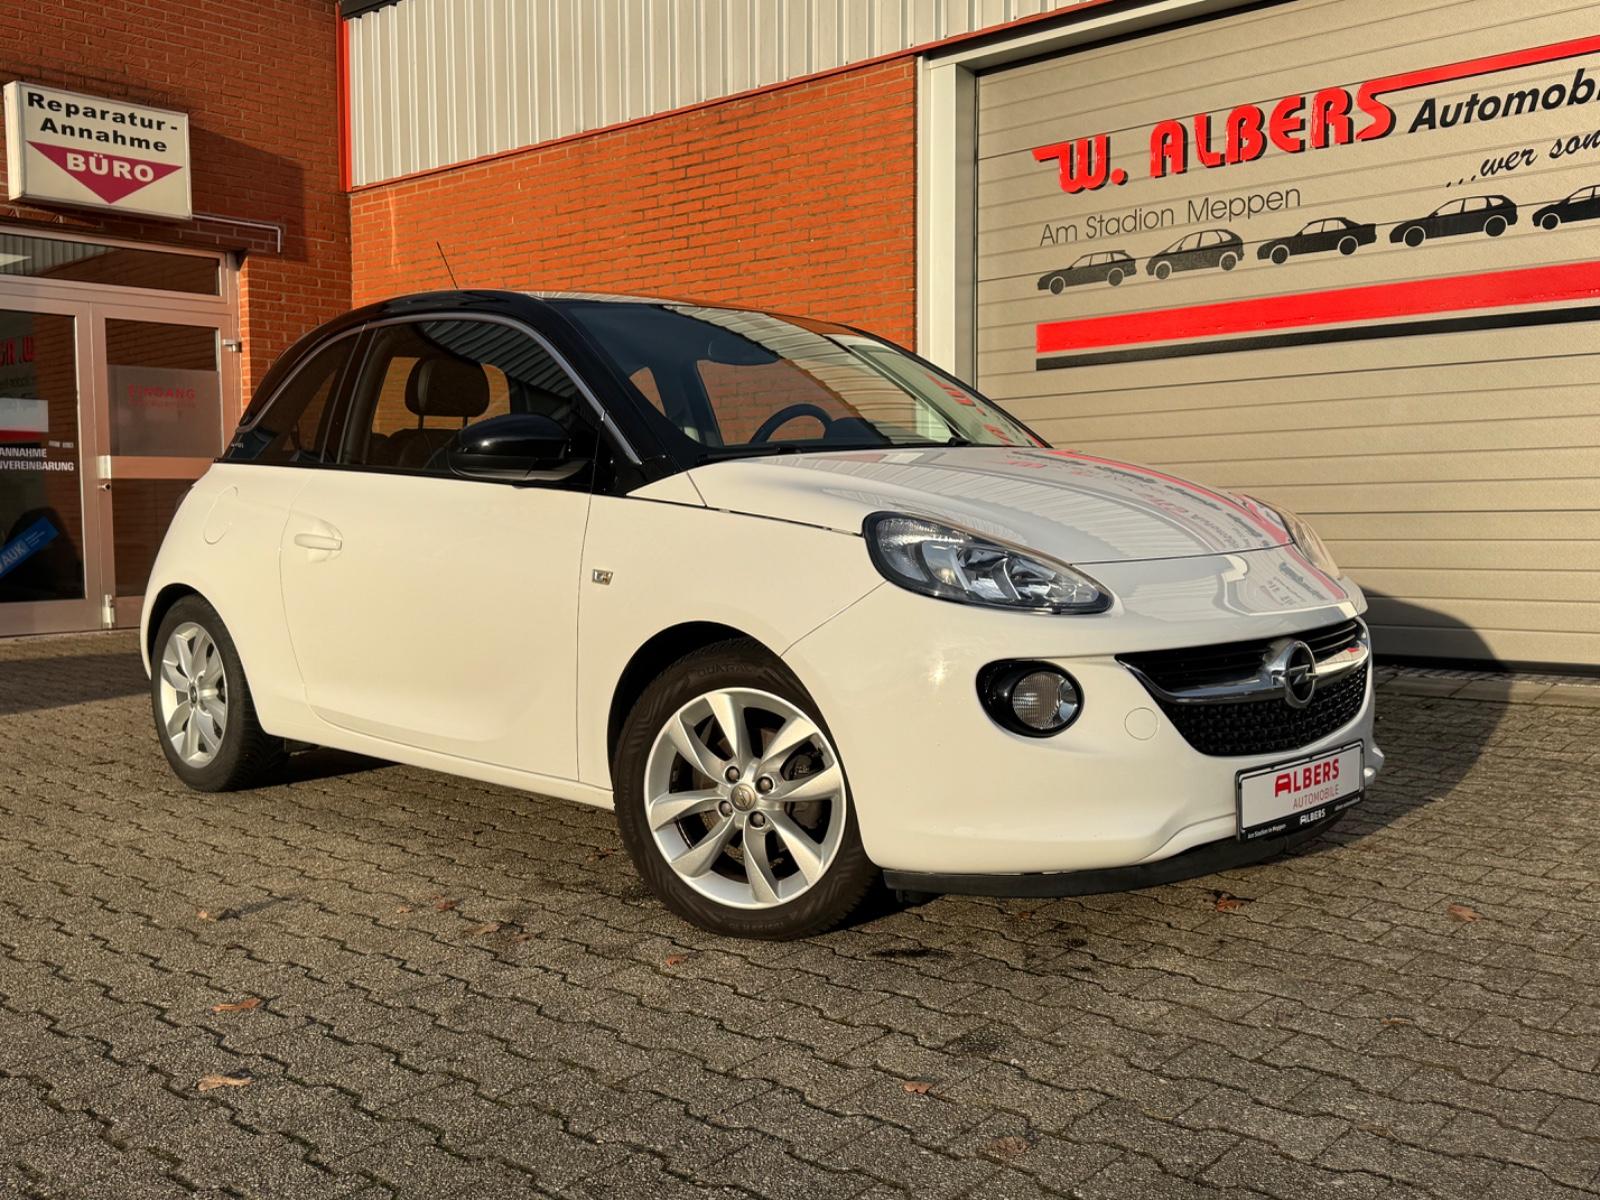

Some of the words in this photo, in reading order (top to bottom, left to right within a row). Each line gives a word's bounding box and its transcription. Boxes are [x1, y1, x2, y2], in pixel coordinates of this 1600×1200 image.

[27, 92, 178, 131] Reparatur-
[40, 117, 167, 152] Annahme
[1032, 134, 1128, 194] W.
[1150, 81, 1397, 178] ALBERS
[1408, 68, 1600, 135] Automob
[66, 152, 154, 182] BÜRO
[1040, 223, 1078, 247] Am
[1086, 208, 1174, 239] Stadion
[1187, 188, 1301, 222] Meppen
[1274, 758, 1340, 798] ALBERS
[1293, 784, 1340, 810] AUTOMOBILE
[1299, 808, 1326, 825] ALBERS
